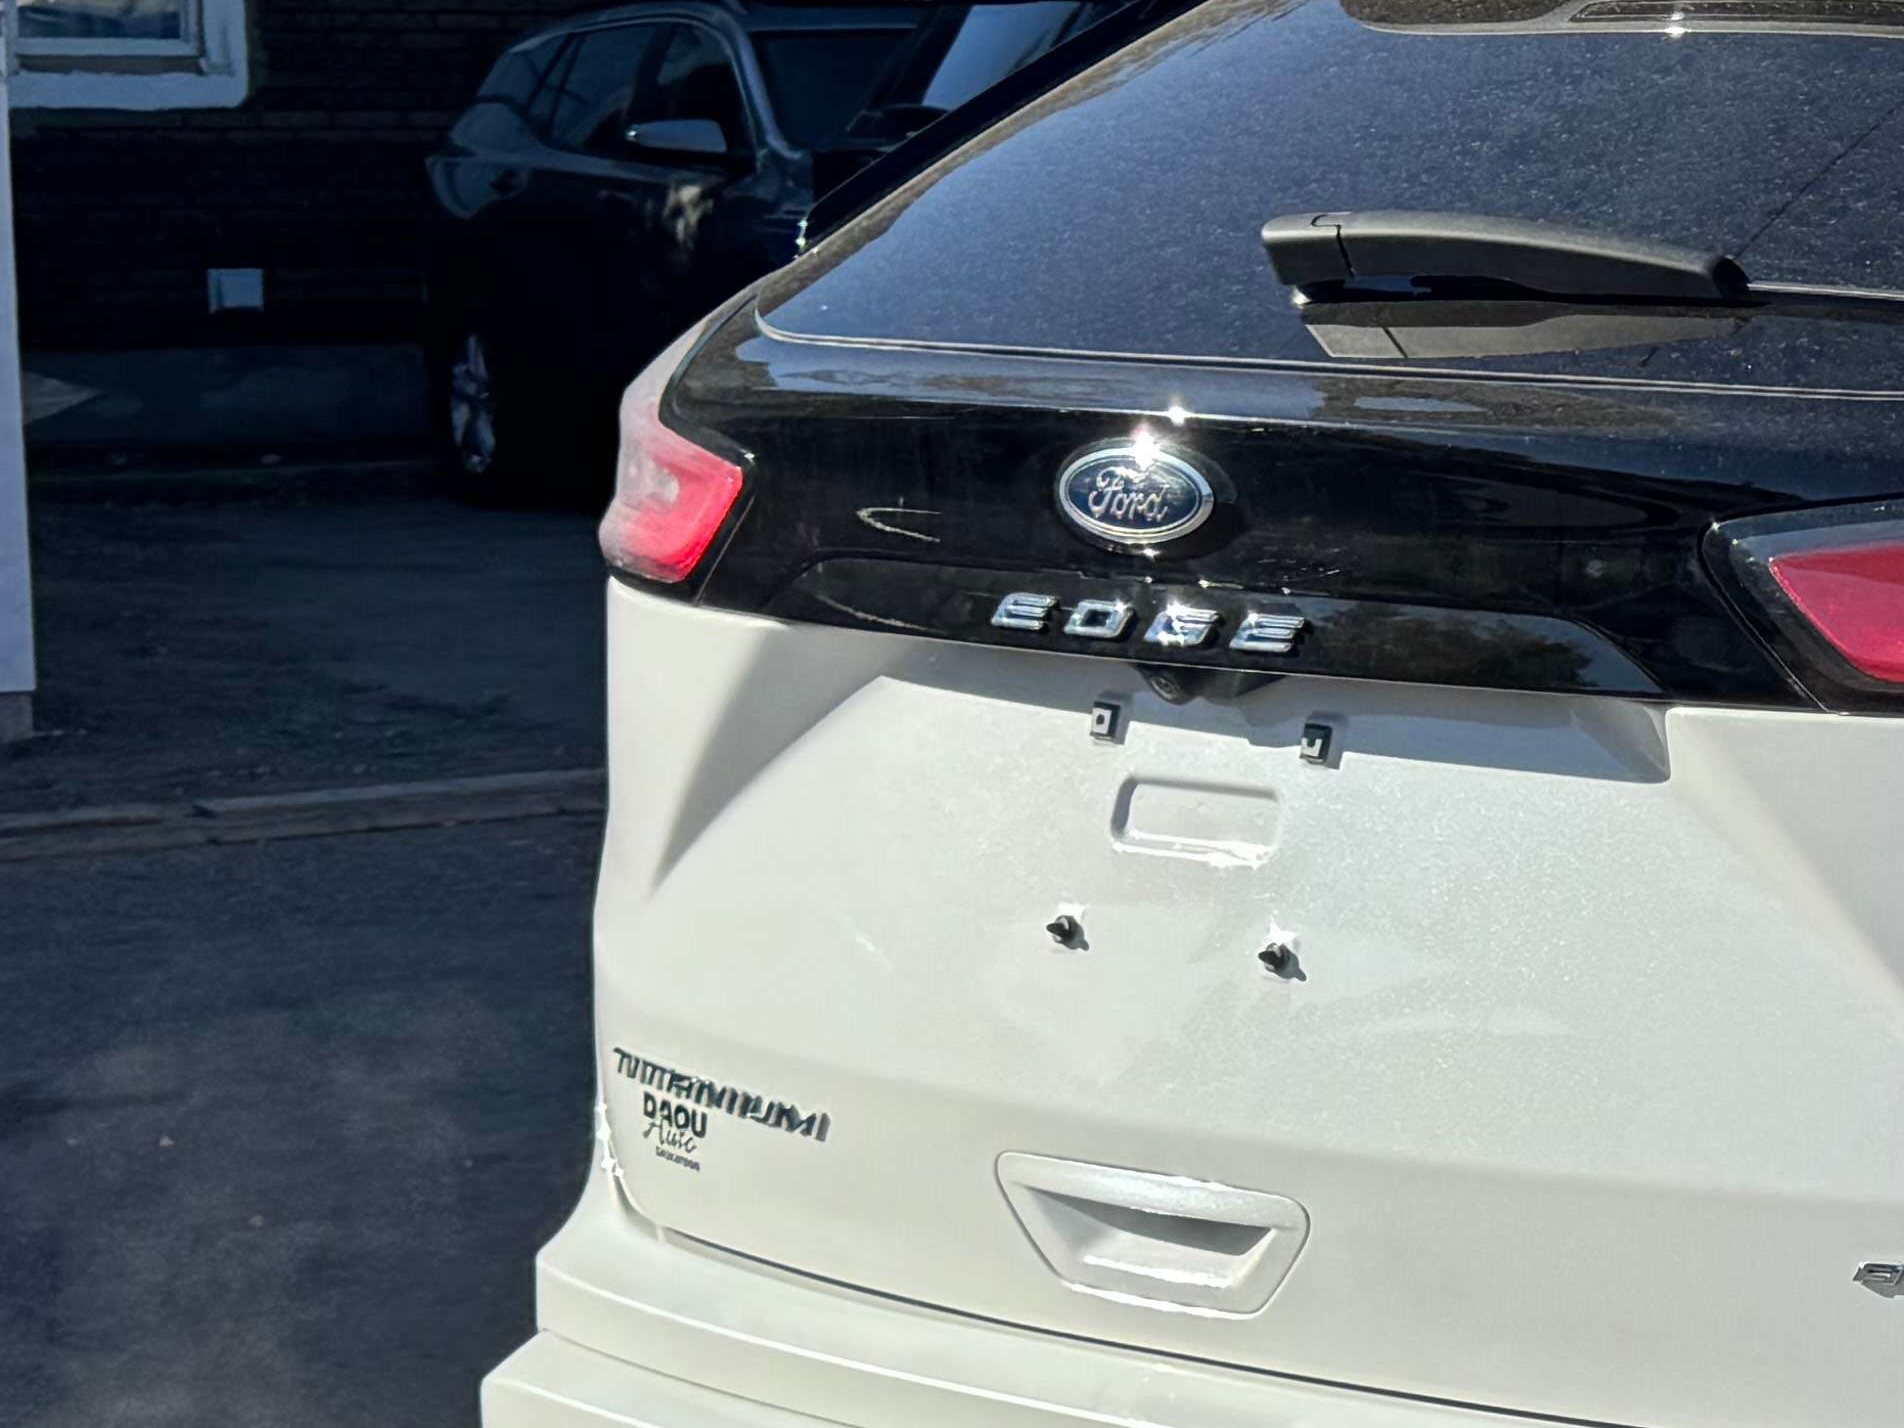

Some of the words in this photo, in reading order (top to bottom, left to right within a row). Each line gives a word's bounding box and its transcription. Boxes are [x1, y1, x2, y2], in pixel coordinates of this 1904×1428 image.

[1087, 465, 1171, 522] Ford
[991, 592, 1306, 654] EDGE
[643, 1090, 708, 1139] DAOU
